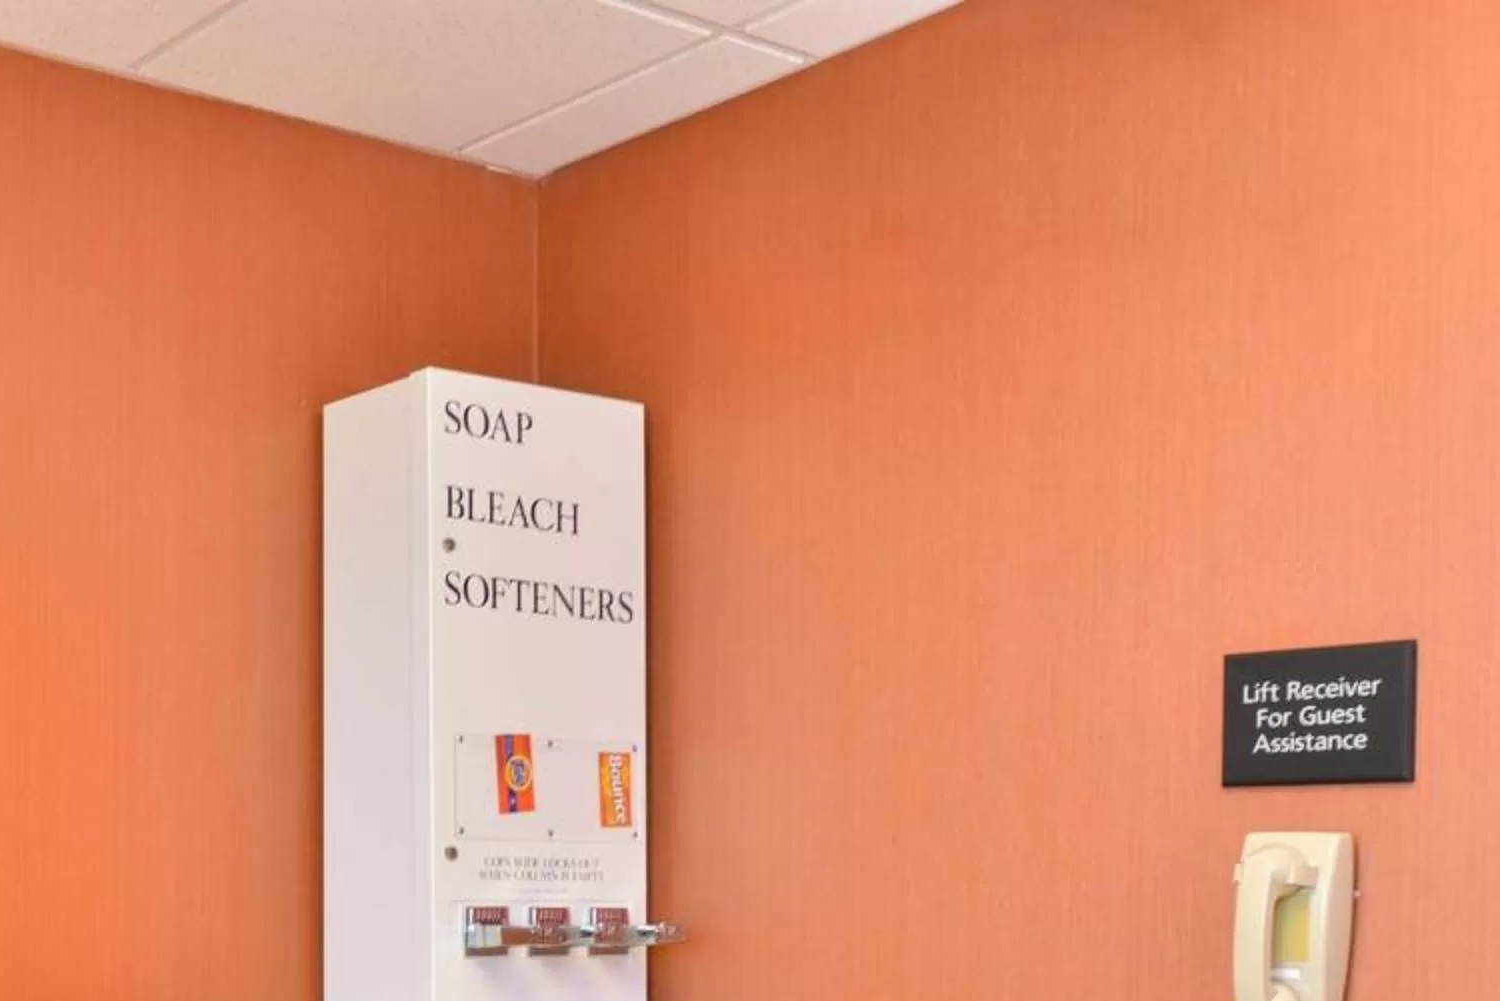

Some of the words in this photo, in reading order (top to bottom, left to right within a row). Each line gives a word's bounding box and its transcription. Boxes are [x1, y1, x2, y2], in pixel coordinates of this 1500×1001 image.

[444, 400, 533, 446] SOAP
[446, 484, 580, 535] BLEACH
[443, 570, 635, 624] SOFTENERS
[1242, 681, 1280, 704] Lift
[1286, 677, 1382, 701] Receiver
[1255, 708, 1292, 728] For
[1299, 704, 1366, 727] Guest
[1252, 732, 1368, 754] Assistance
[609, 754, 626, 825] Bounce
